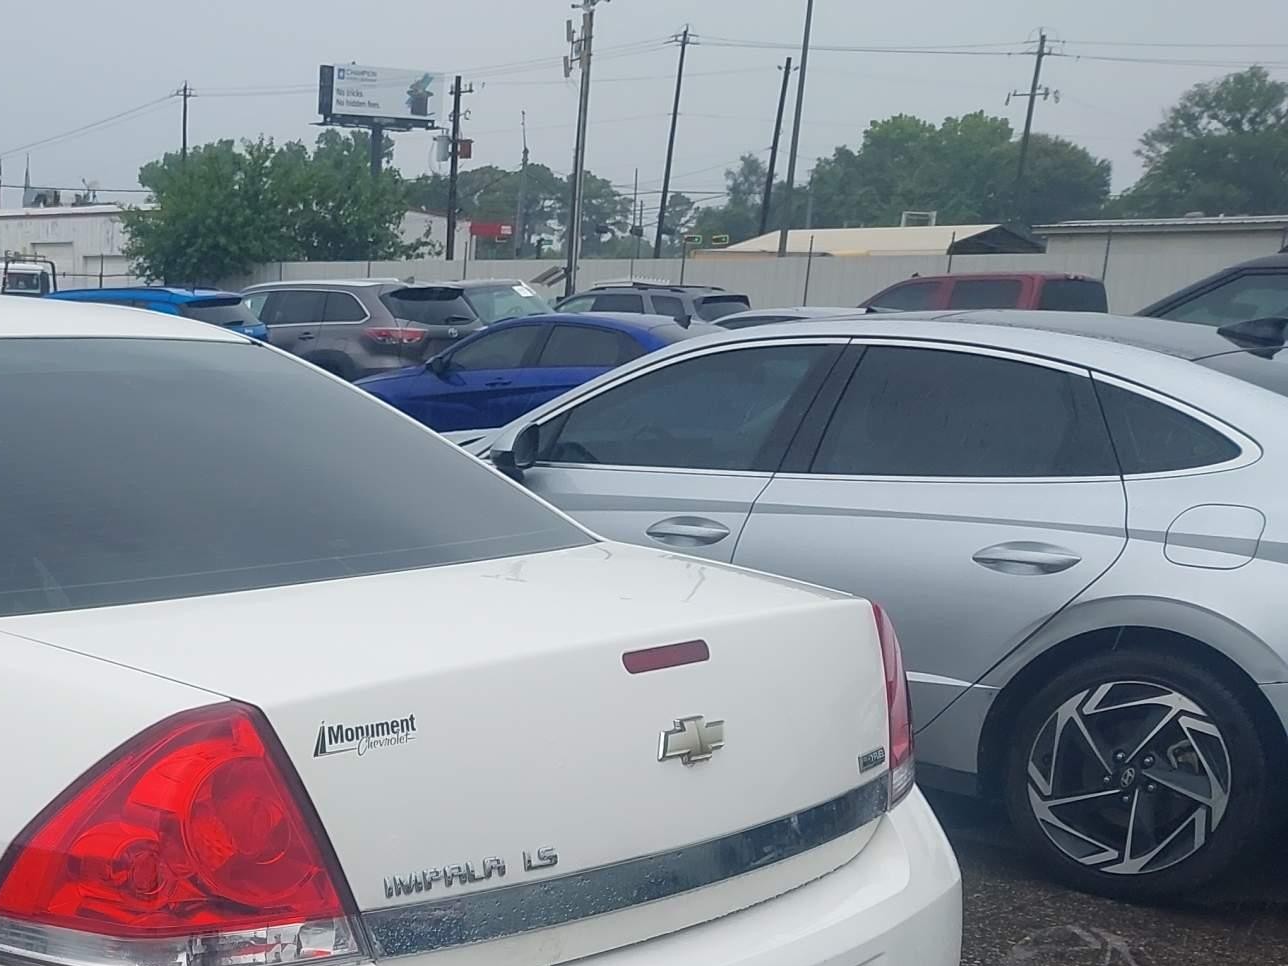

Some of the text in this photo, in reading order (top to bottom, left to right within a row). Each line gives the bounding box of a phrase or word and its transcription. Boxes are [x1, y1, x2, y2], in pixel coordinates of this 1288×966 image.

[336, 87, 345, 97] No
[336, 98, 345, 106] No
[346, 99, 366, 107] hidden
[327, 713, 416, 746] Monument
[357, 728, 412, 757] Chevrolet
[384, 847, 559, 898] IMPALA LS
